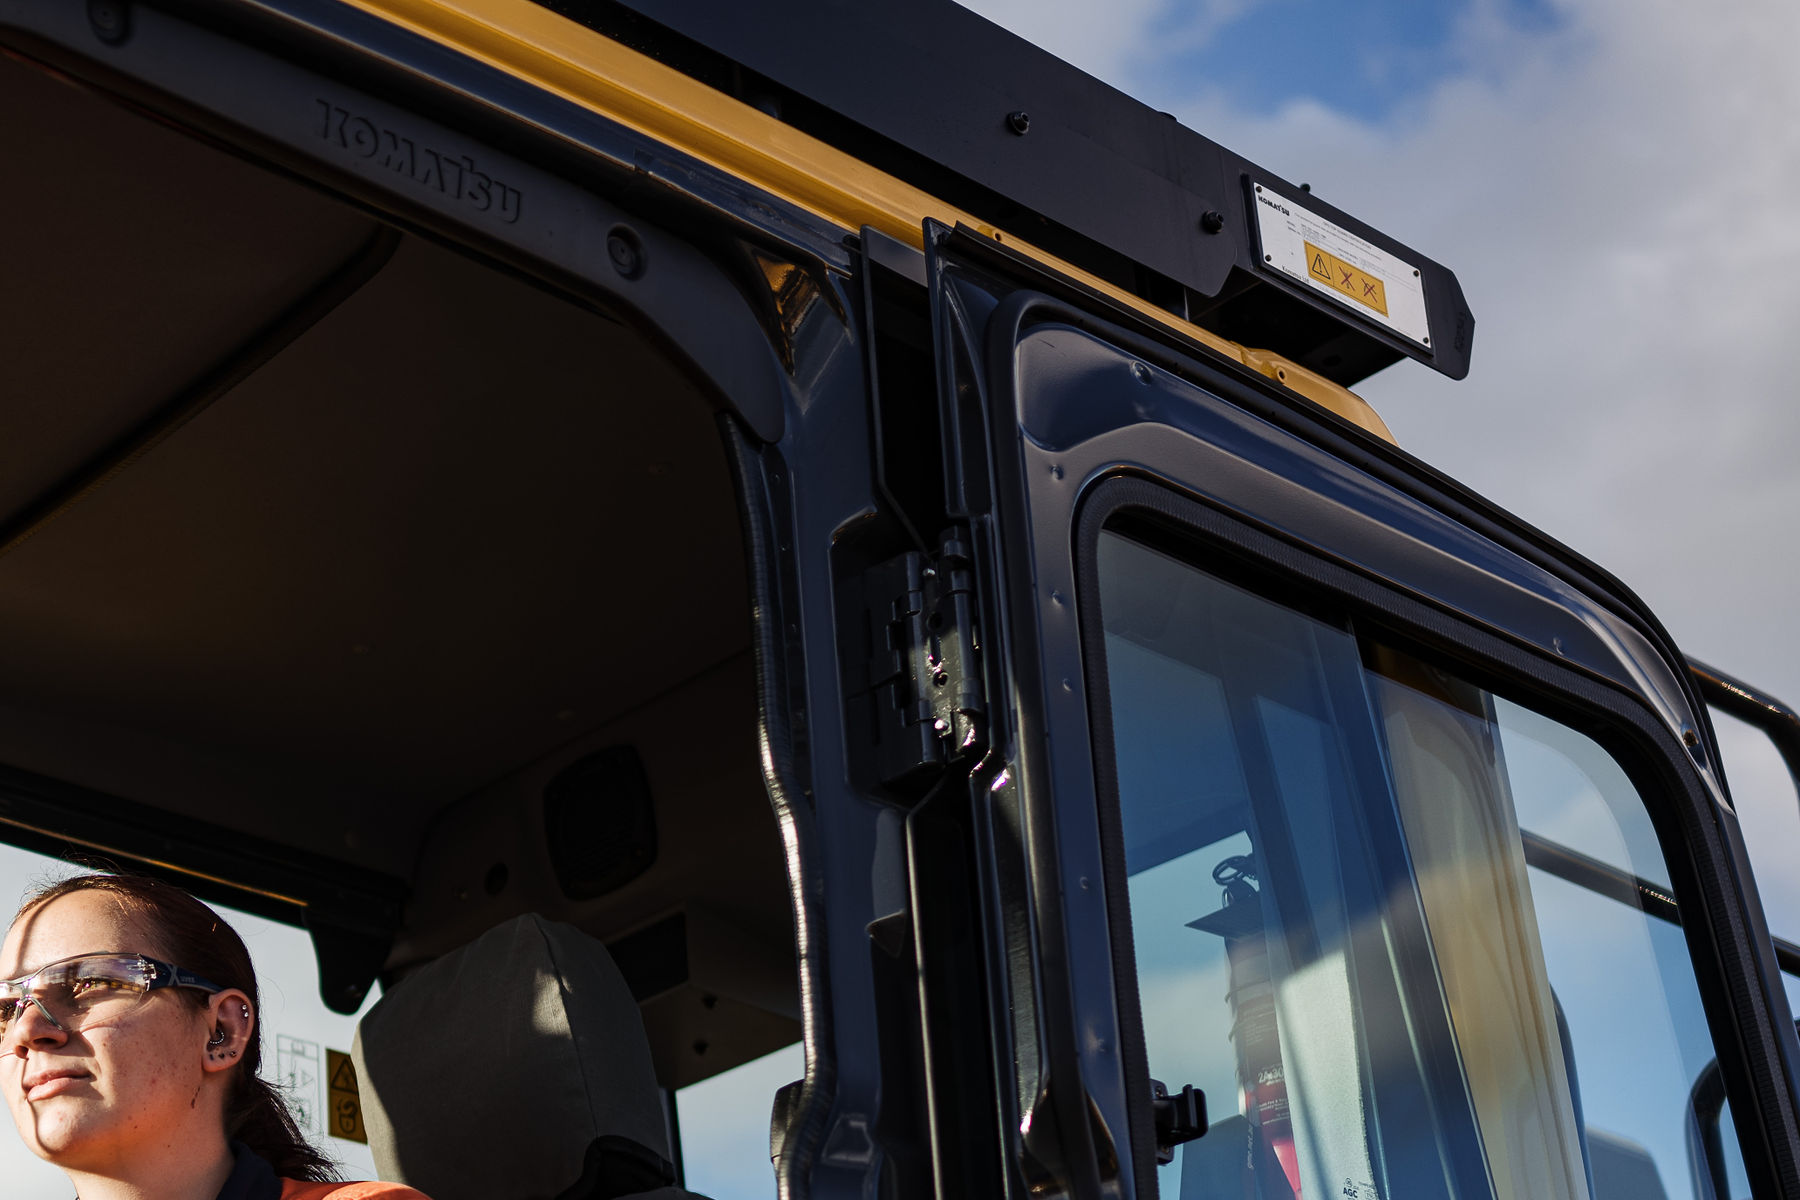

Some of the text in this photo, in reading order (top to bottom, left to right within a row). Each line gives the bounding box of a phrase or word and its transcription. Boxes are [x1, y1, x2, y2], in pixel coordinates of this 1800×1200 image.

[315, 97, 522, 225] KOMATSU
[1258, 195, 1290, 216] KOMATSU
[1343, 1187, 1358, 1199] AGC
